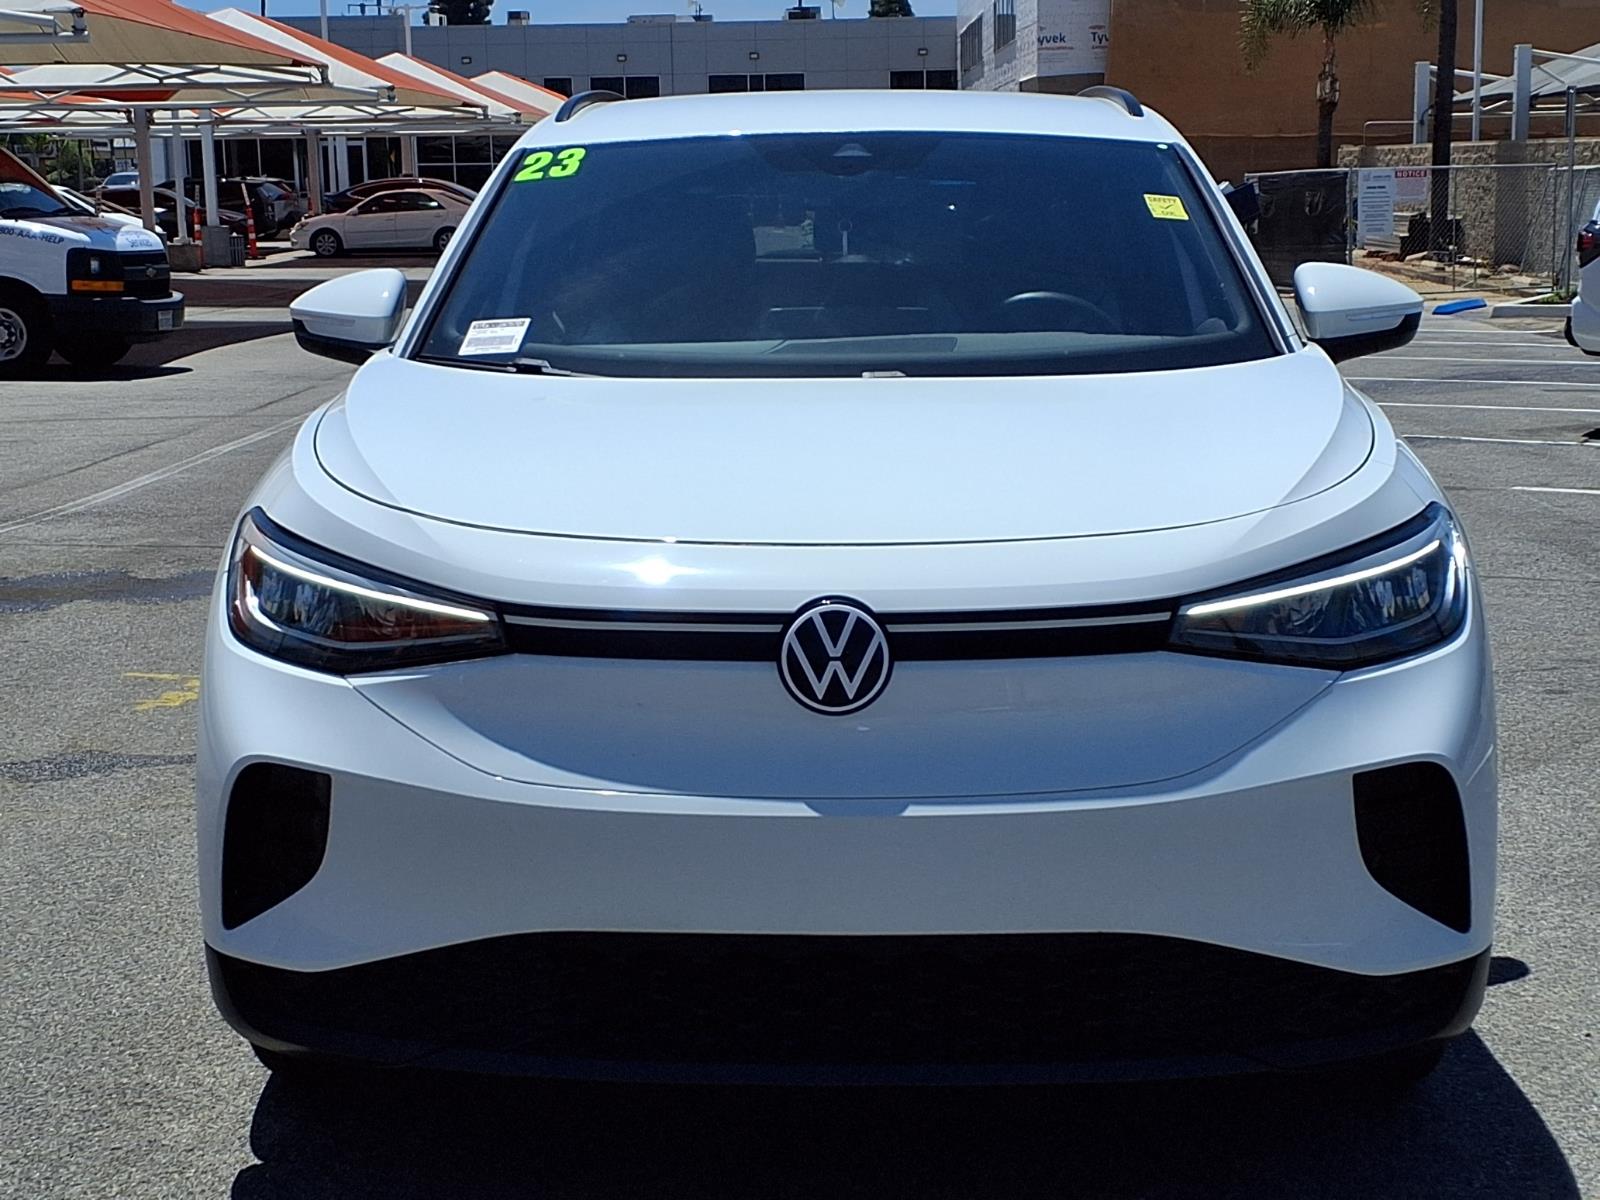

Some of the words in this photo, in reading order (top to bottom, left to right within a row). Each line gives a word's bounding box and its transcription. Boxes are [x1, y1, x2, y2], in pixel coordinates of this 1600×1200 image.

[1037, 32, 1066, 46] yvek
[514, 147, 586, 181] 23
[787, 610, 881, 700] VW
